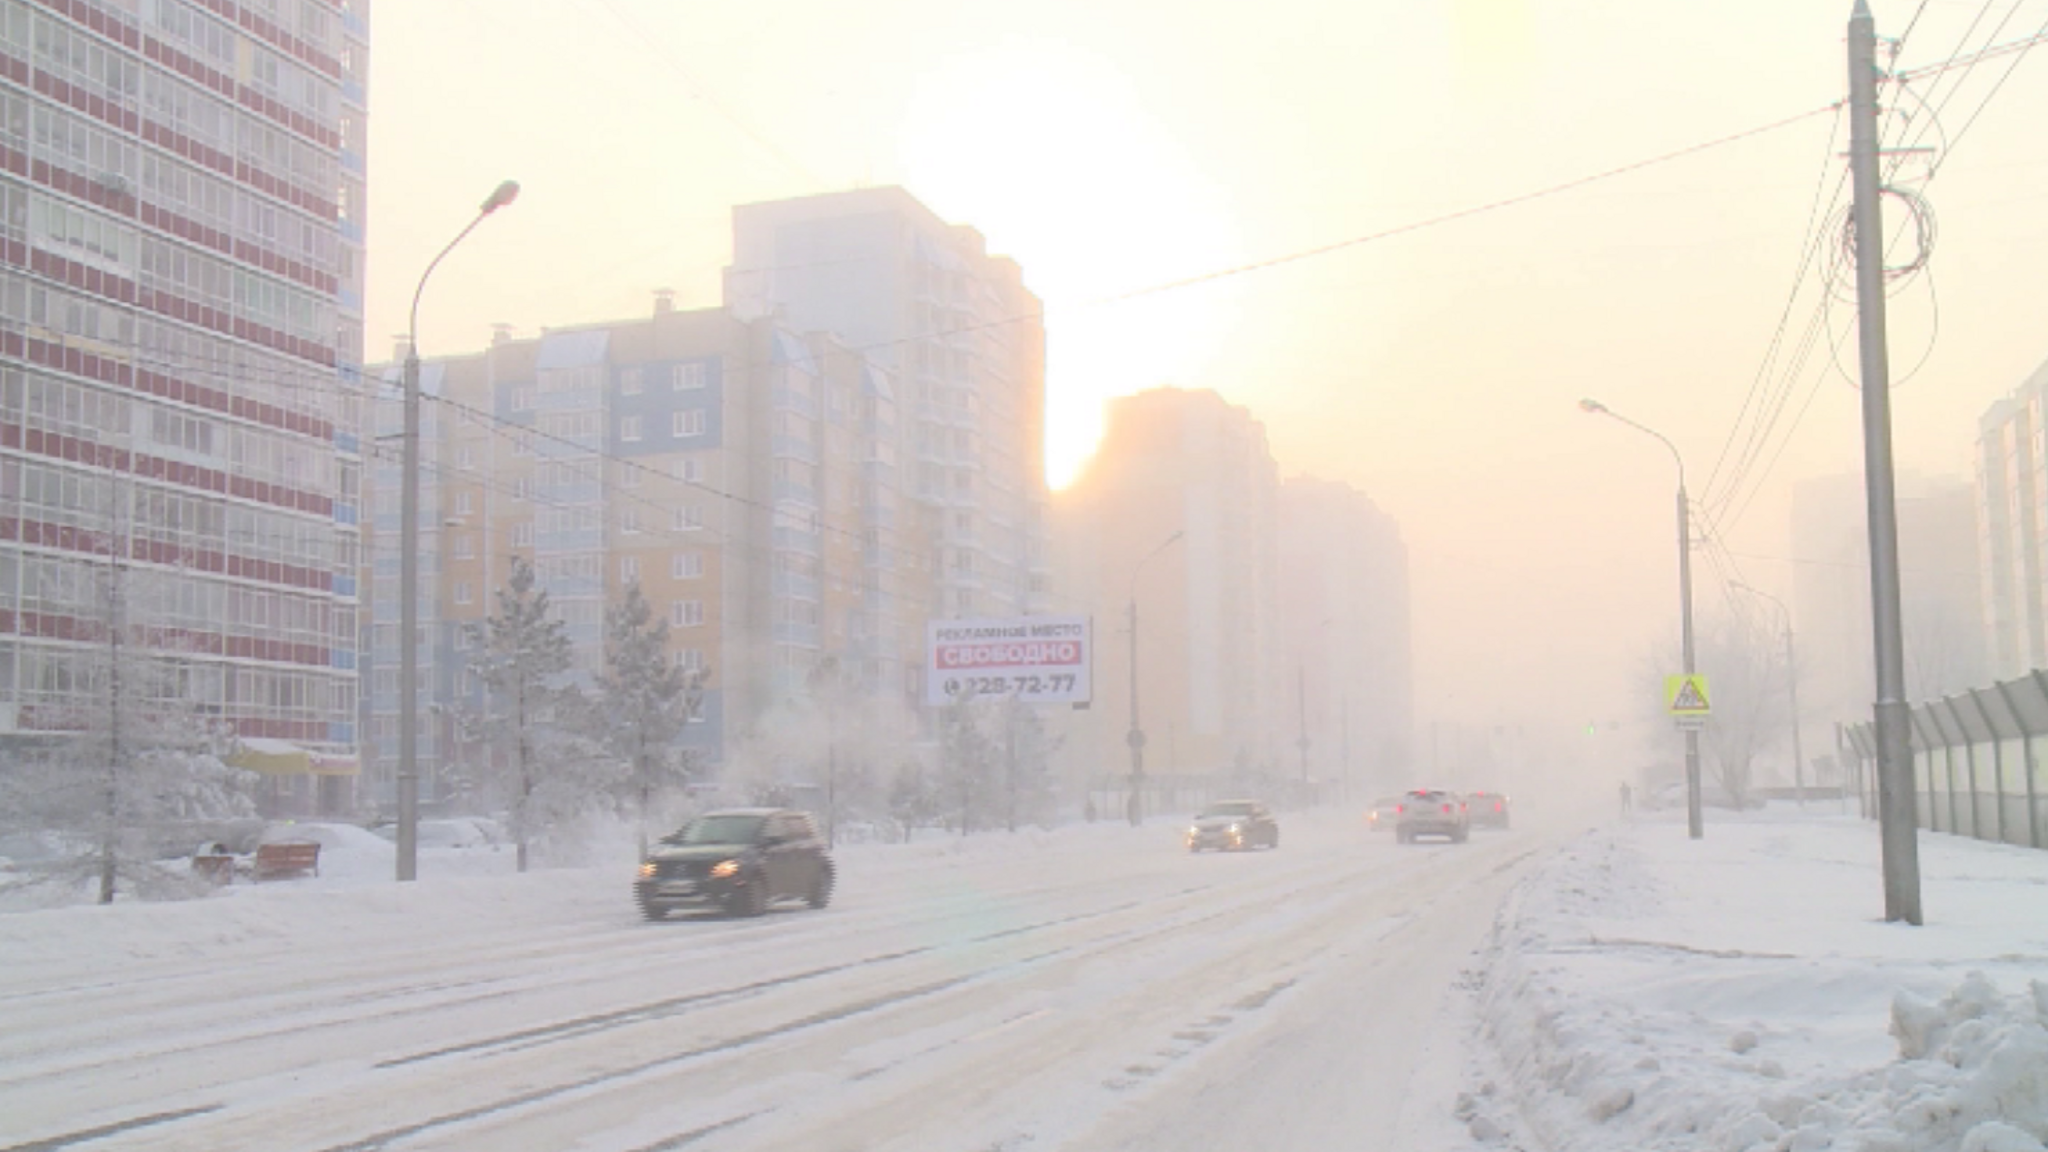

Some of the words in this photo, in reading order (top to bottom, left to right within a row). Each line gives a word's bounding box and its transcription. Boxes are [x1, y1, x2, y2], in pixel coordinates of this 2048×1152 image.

[936, 626, 1027, 641] РЕКЛАМНОЕ
[1031, 624, 1082, 637] МЕСТО
[943, 643, 1074, 667] СВОБОДНО
